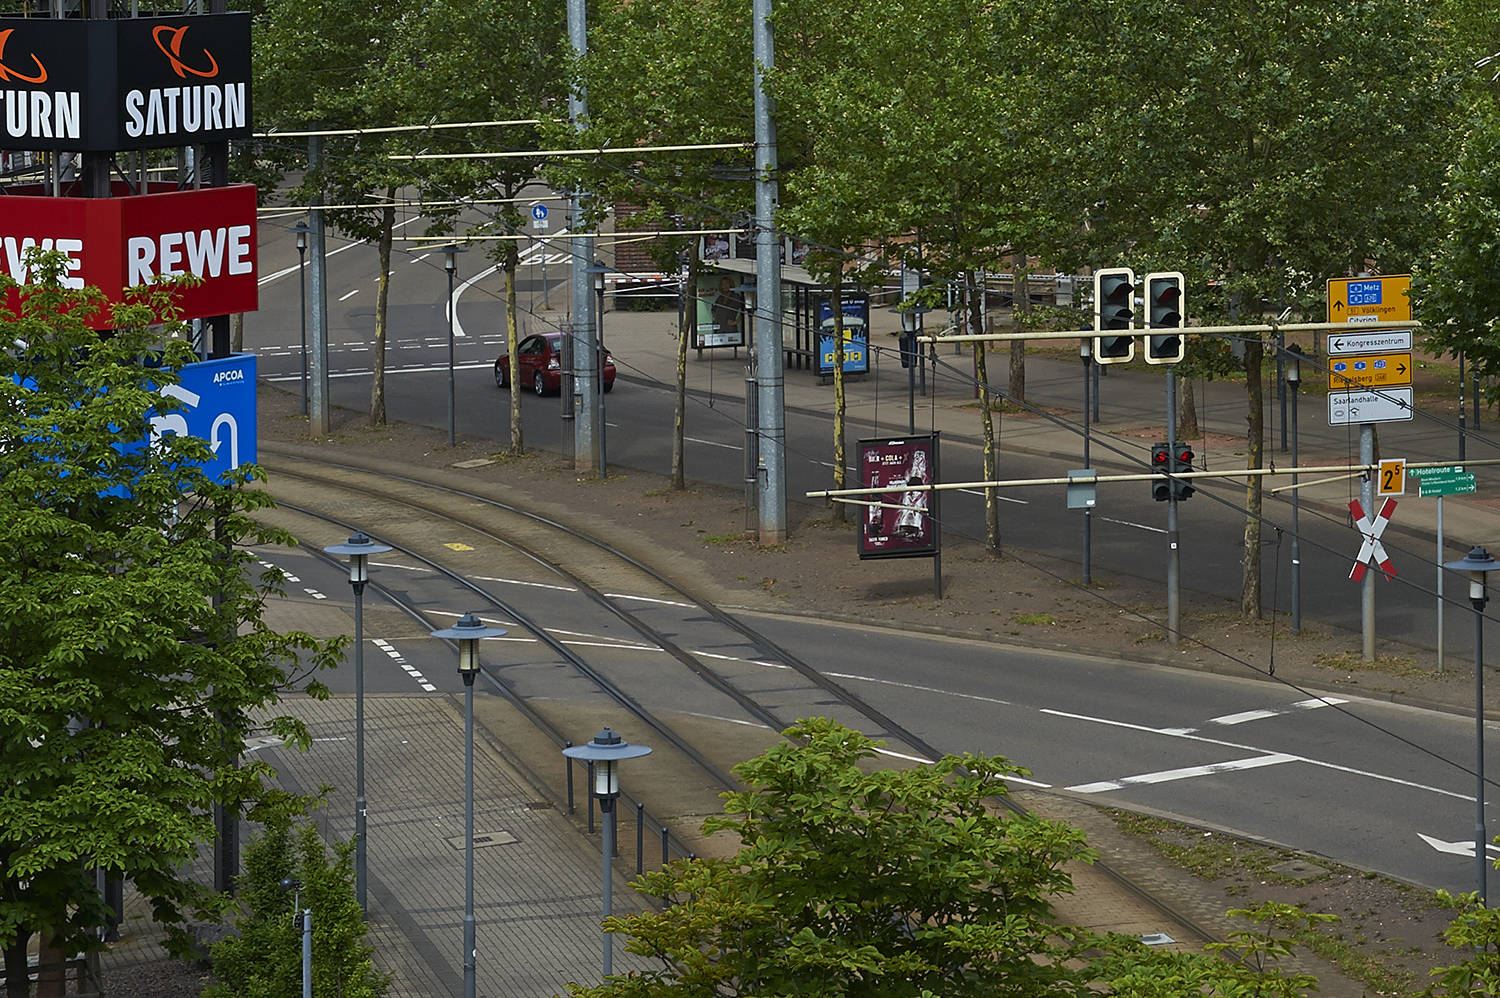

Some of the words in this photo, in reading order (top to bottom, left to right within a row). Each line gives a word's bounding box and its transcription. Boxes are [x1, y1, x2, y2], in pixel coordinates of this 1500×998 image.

[0, 89, 81, 139] URN
[125, 82, 246, 138] SATURN
[0, 236, 85, 290] WE
[127, 224, 253, 288] REWE
[520, 253, 573, 266] BU
[1361, 306, 1396, 314] Völklingen
[1346, 338, 1404, 348] Kongresszentrum
[213, 369, 244, 383] APCOA
[1416, 467, 1451, 475] Hotelroute
